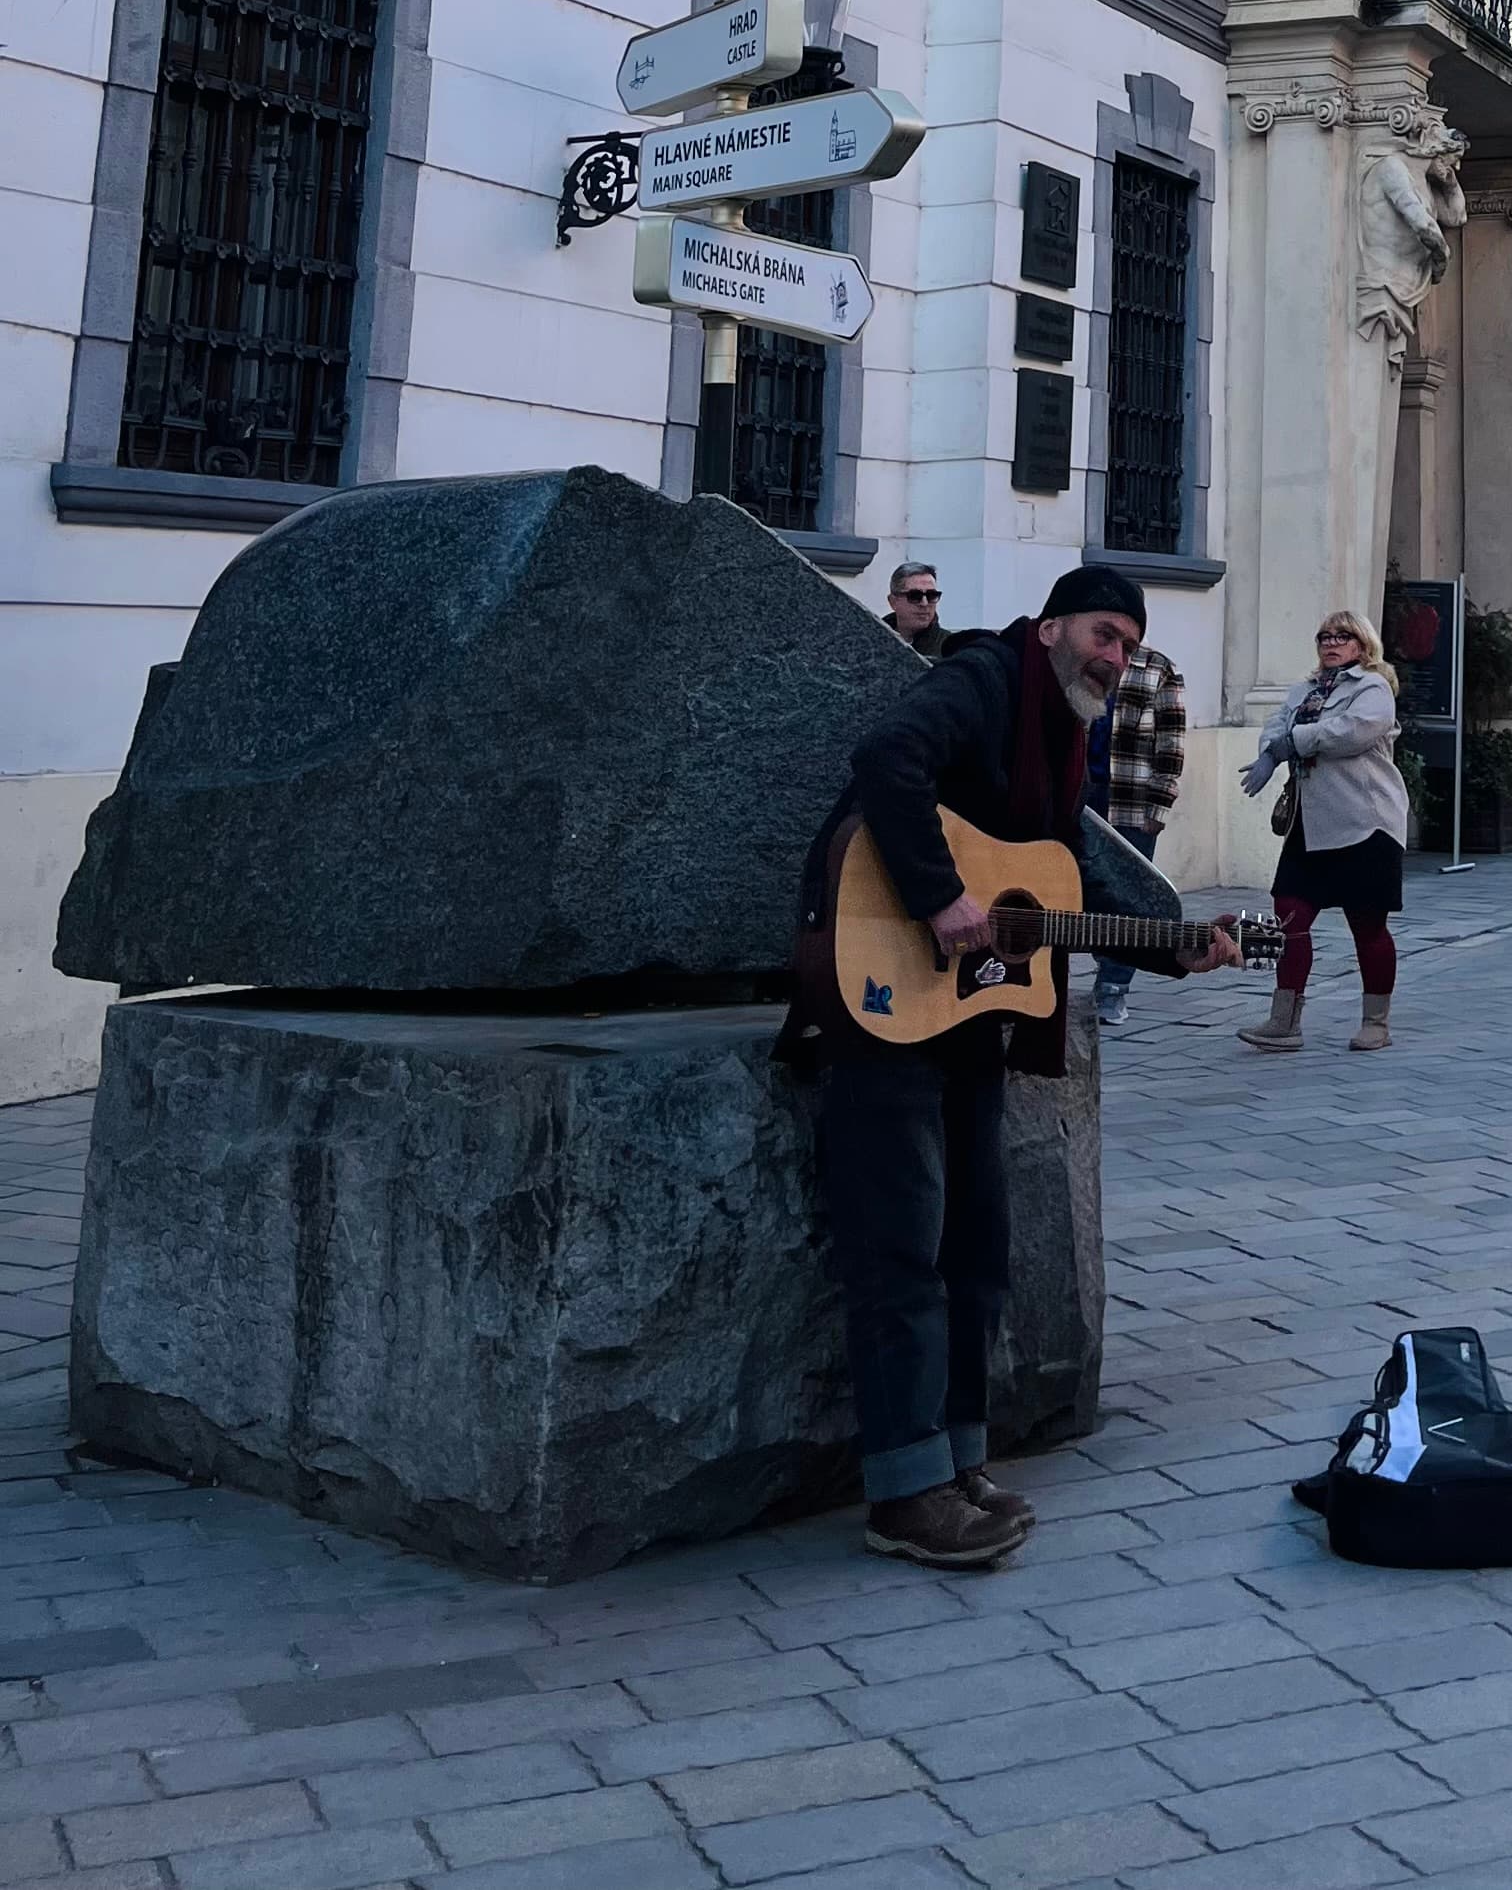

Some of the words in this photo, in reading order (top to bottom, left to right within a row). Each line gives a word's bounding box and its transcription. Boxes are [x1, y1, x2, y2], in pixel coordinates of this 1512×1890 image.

[729, 9, 758, 39] HRAD
[727, 39, 757, 65] CASTLE
[654, 132, 712, 167] HLAVNÉ
[715, 121, 792, 156] NÁMESTIE
[652, 169, 684, 195] MAIN
[685, 163, 733, 189] SQUARE
[684, 237, 761, 277] MICHALSKÁ
[763, 255, 806, 287] BRÁNA
[682, 269, 738, 299] MICHAEL'S
[738, 281, 766, 305] GATE
